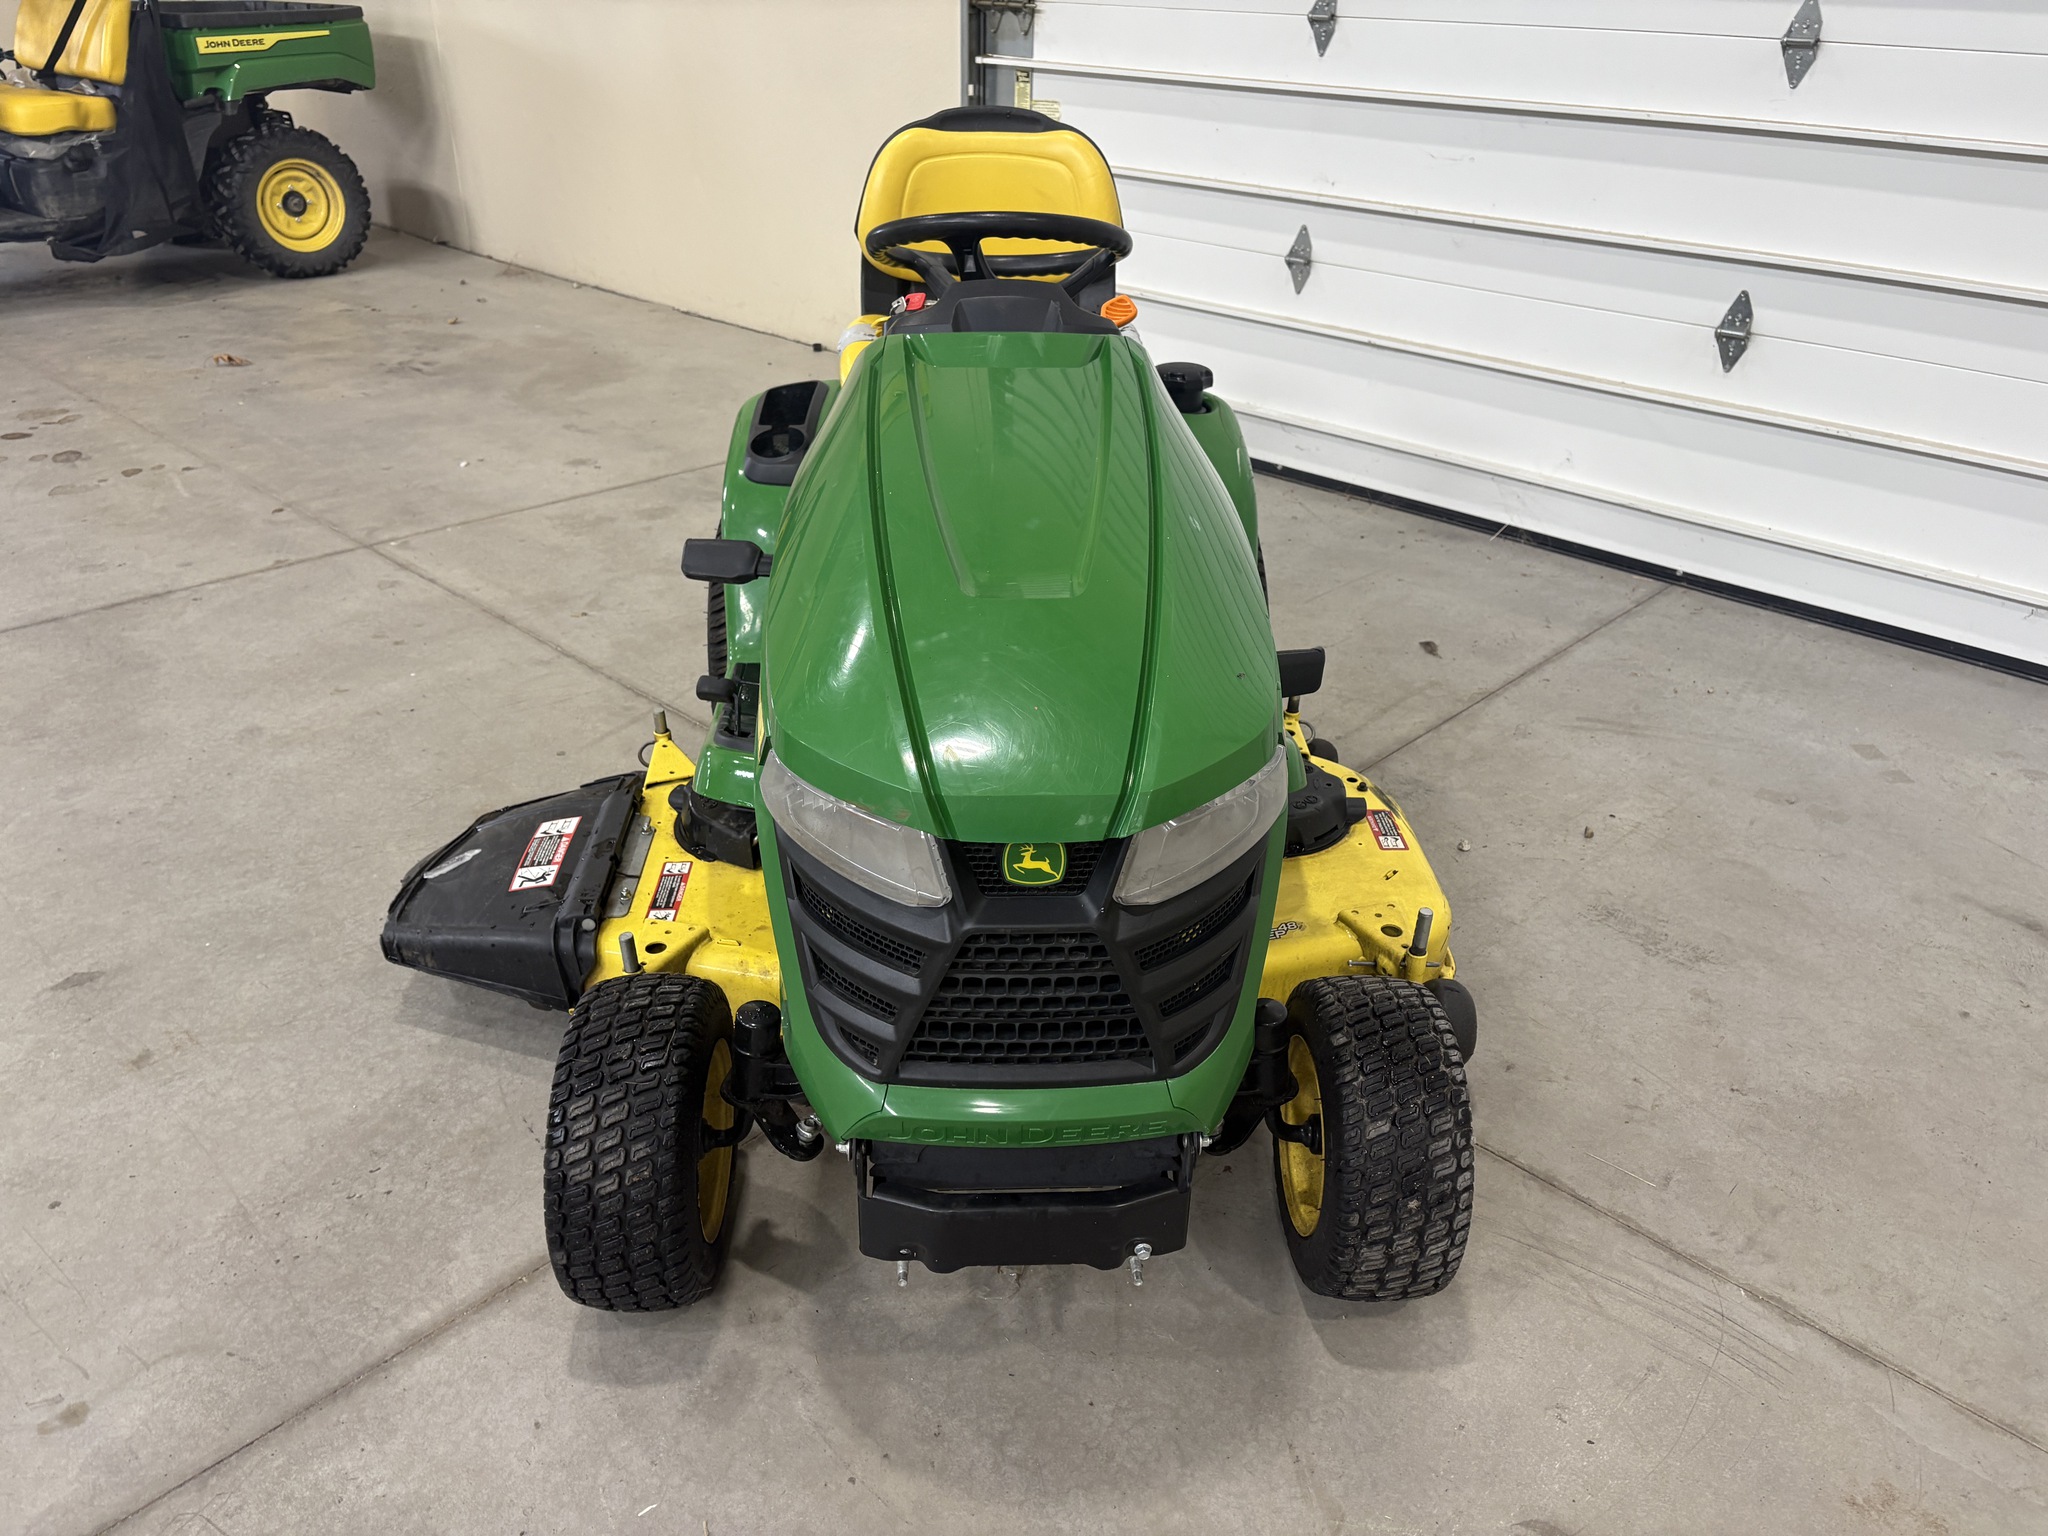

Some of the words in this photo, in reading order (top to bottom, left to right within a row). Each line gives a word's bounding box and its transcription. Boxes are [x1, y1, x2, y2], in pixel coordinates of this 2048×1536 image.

[204, 39, 231, 49] JOHN
[232, 38, 266, 47] DEERE
[888, 1121, 1009, 1145] JOHN
[1020, 1120, 1168, 1145] DEERE
